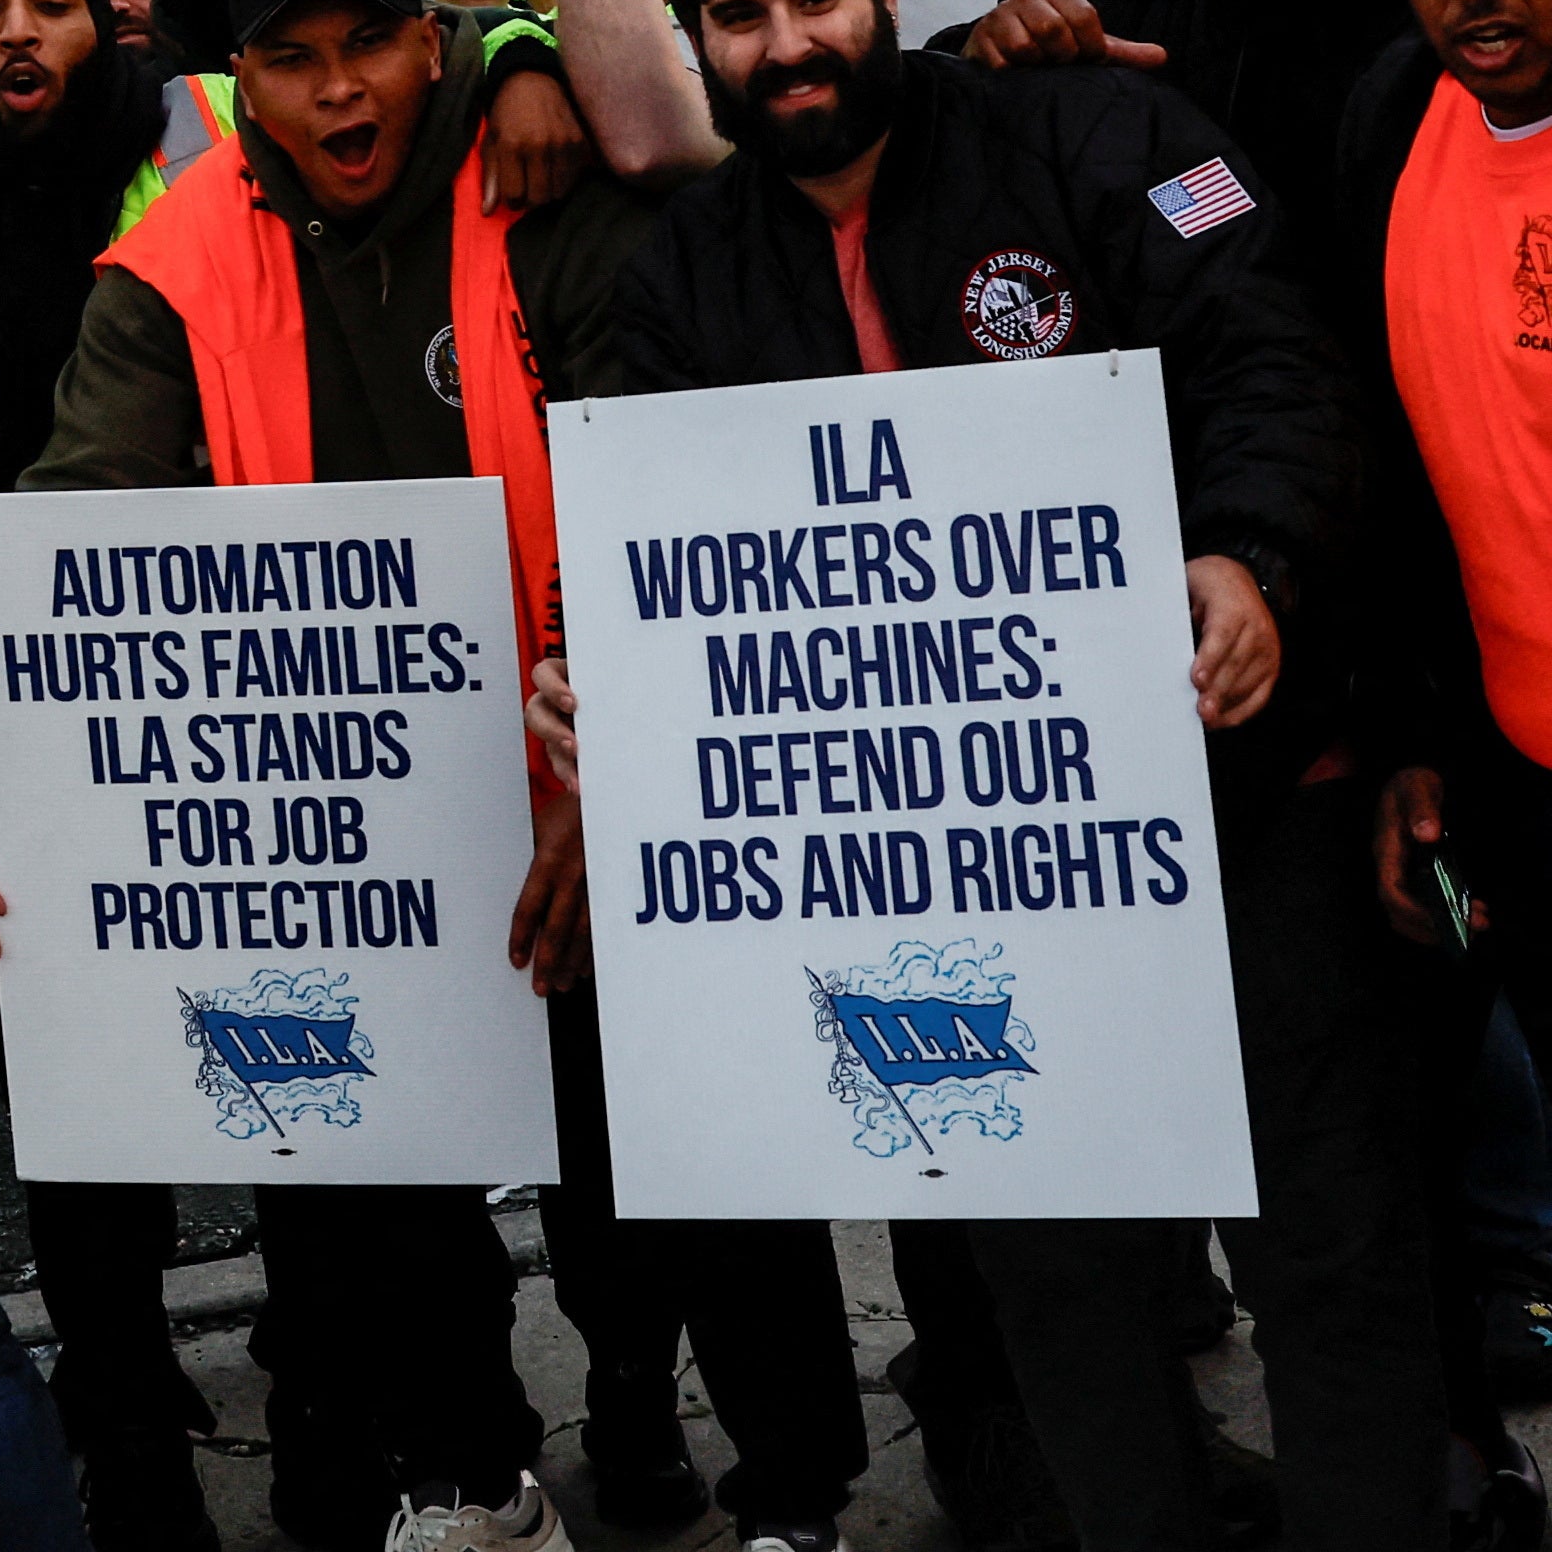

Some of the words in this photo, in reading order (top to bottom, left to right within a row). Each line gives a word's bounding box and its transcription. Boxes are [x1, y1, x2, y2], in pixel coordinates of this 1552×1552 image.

[965, 270, 985, 314] NEW
[987, 252, 1057, 278] JERSEY
[971, 290, 1073, 360] LONGSHOREMEN
[809, 419, 911, 506] ILA
[52, 538, 417, 617] AUTOMATION
[626, 519, 936, 620] WORKERS
[950, 505, 1127, 598] OVER
[3, 631, 189, 702] HURTS
[201, 622, 482, 698] FAMILIES:
[706, 614, 1061, 717] MACHINES:
[87, 716, 178, 784] ILA
[188, 710, 411, 783] STANDS
[697, 726, 944, 819] DEFEND
[960, 717, 1097, 807] OUR
[144, 798, 255, 867] FOR
[268, 796, 367, 865] JOB
[636, 837, 782, 924] JOBS
[801, 831, 932, 918] AND
[946, 818, 1188, 913] RIGHTS
[91, 879, 439, 950] PROTECTION
